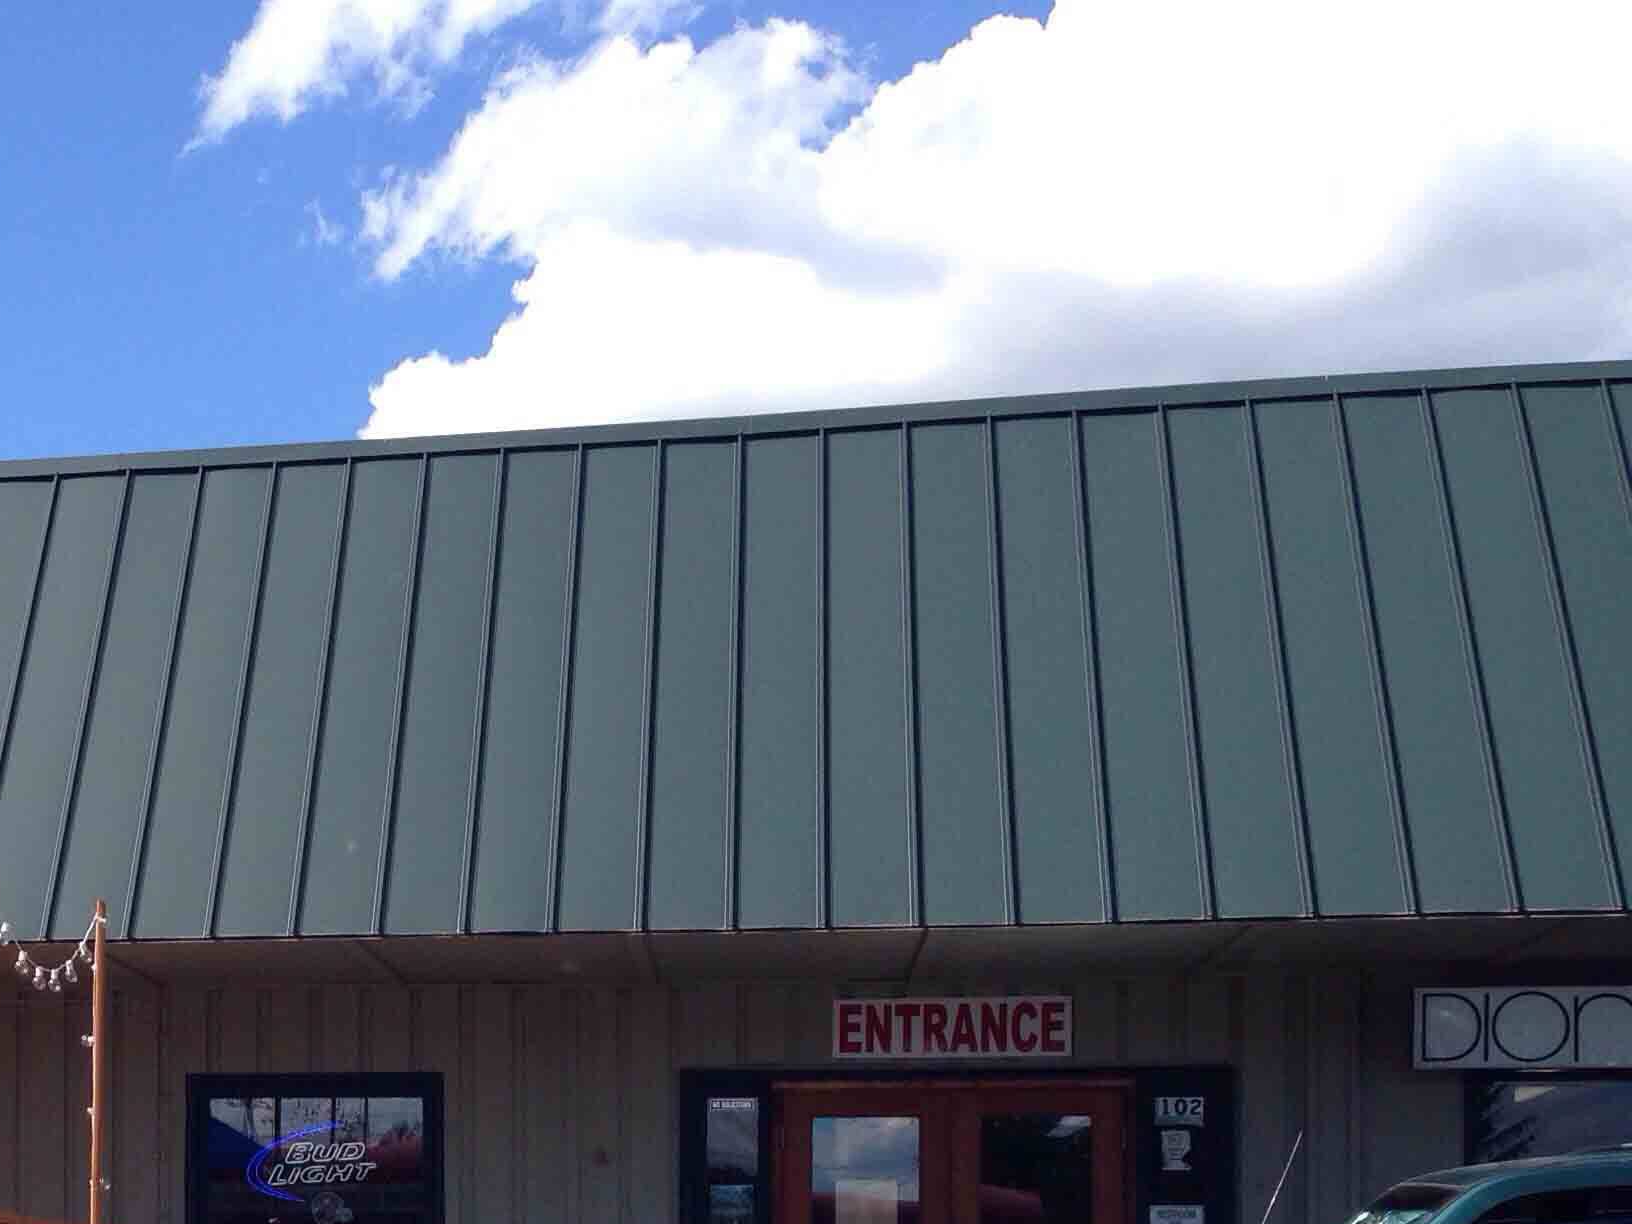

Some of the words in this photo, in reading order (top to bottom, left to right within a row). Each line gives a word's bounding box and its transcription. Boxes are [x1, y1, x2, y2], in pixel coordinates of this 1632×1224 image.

[839, 1002, 1066, 1053] ENTRANCE
[1161, 1098, 1203, 1116] 102
[285, 1141, 366, 1163] BUD
[267, 1163, 377, 1186] LIGHT
